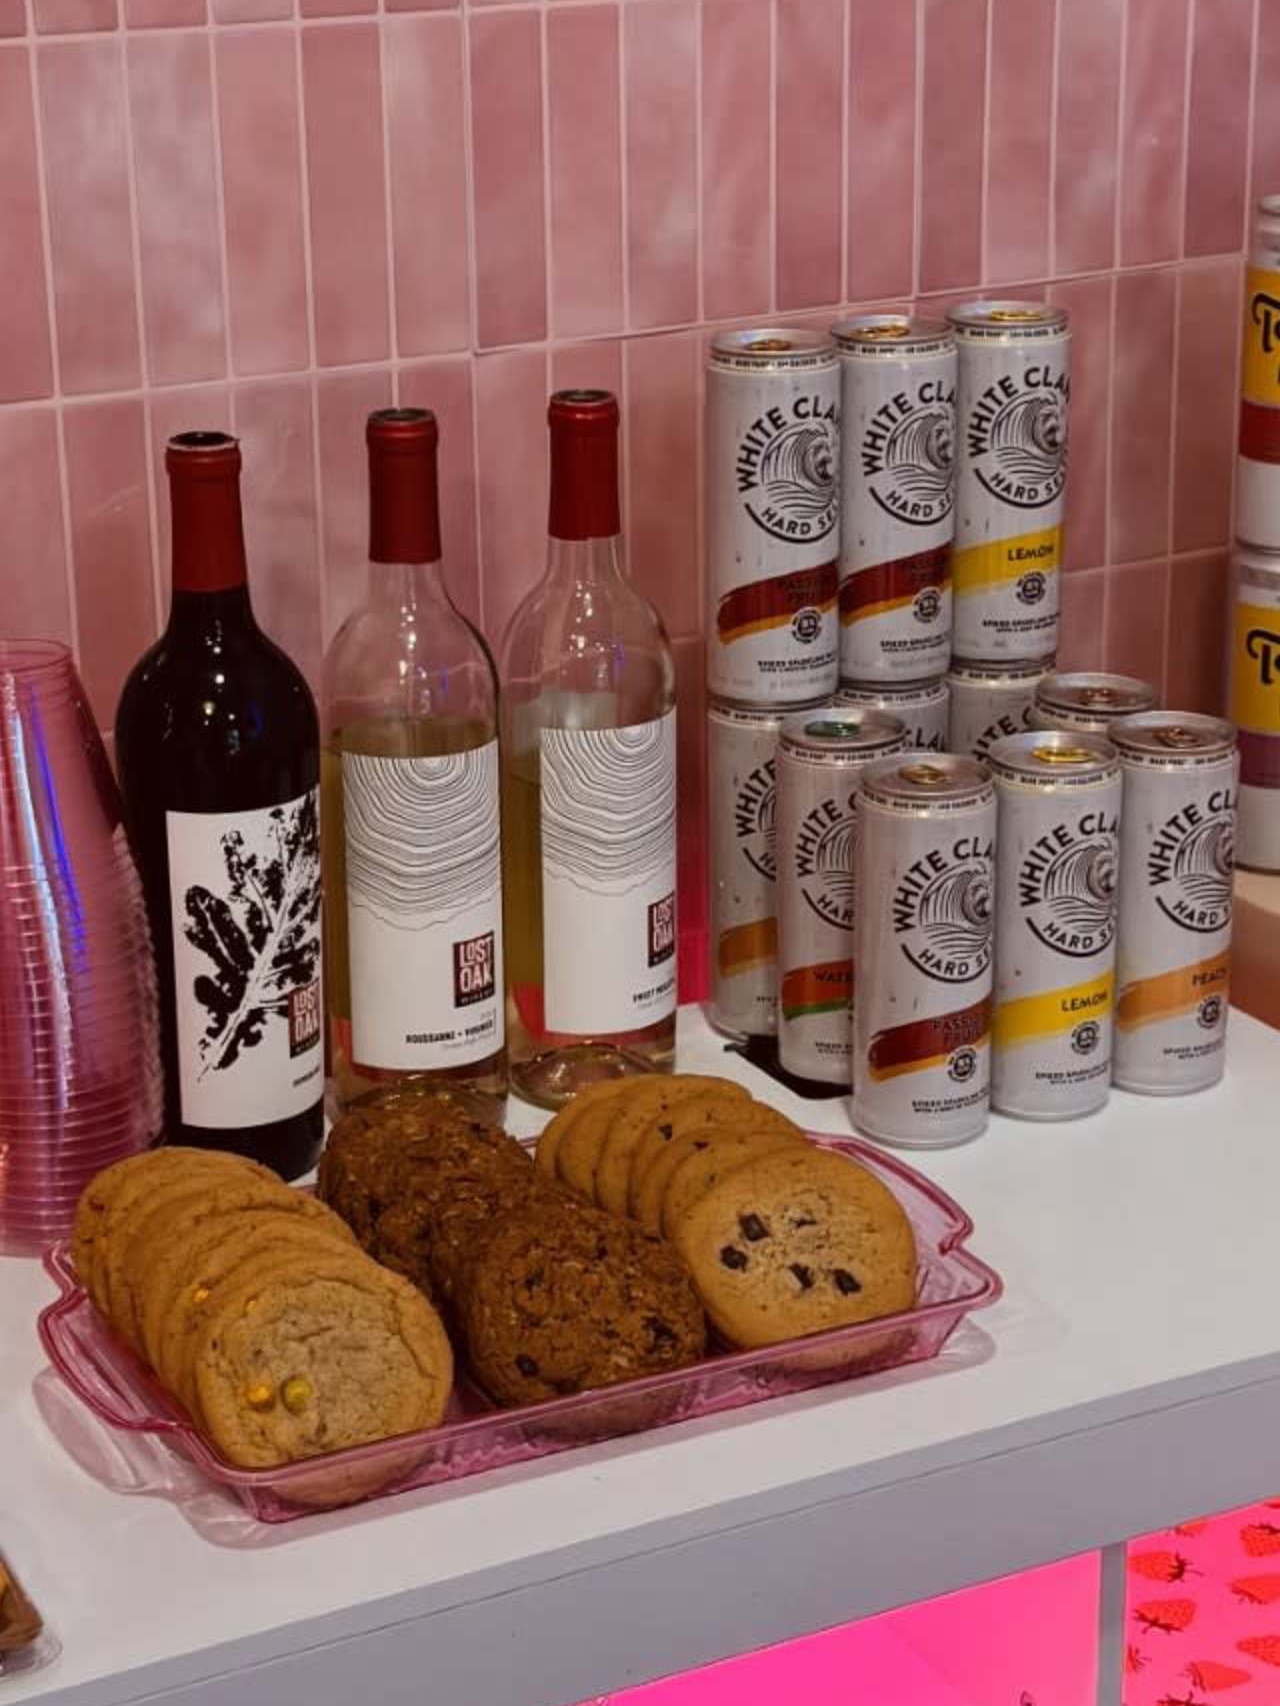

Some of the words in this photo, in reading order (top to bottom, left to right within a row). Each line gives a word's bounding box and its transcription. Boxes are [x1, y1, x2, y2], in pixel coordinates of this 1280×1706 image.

[861, 392, 914, 477] WHITE
[918, 380, 955, 405] CLA
[968, 375, 1019, 458] WHITE
[736, 406, 788, 493] WHITE
[792, 394, 841, 428] CLA
[989, 472, 1039, 501] HARD
[885, 490, 933, 518] HARD
[761, 506, 812, 536] HARD
[1007, 544, 1055, 562] LEMON
[795, 798, 843, 878] WHITE
[1146, 803, 1204, 887] WHITE
[1018, 824, 1074, 907] WHITE
[1079, 811, 1119, 838] CLA
[893, 849, 948, 934] WHITE
[952, 836, 993, 862] CLA
[1172, 900, 1218, 925] HARD
[458, 934, 494, 967] LOST
[1043, 922, 1093, 949] HARD
[459, 960, 494, 993] OAK
[918, 948, 969, 976] HARD
[1061, 990, 1109, 1013] LEMON
